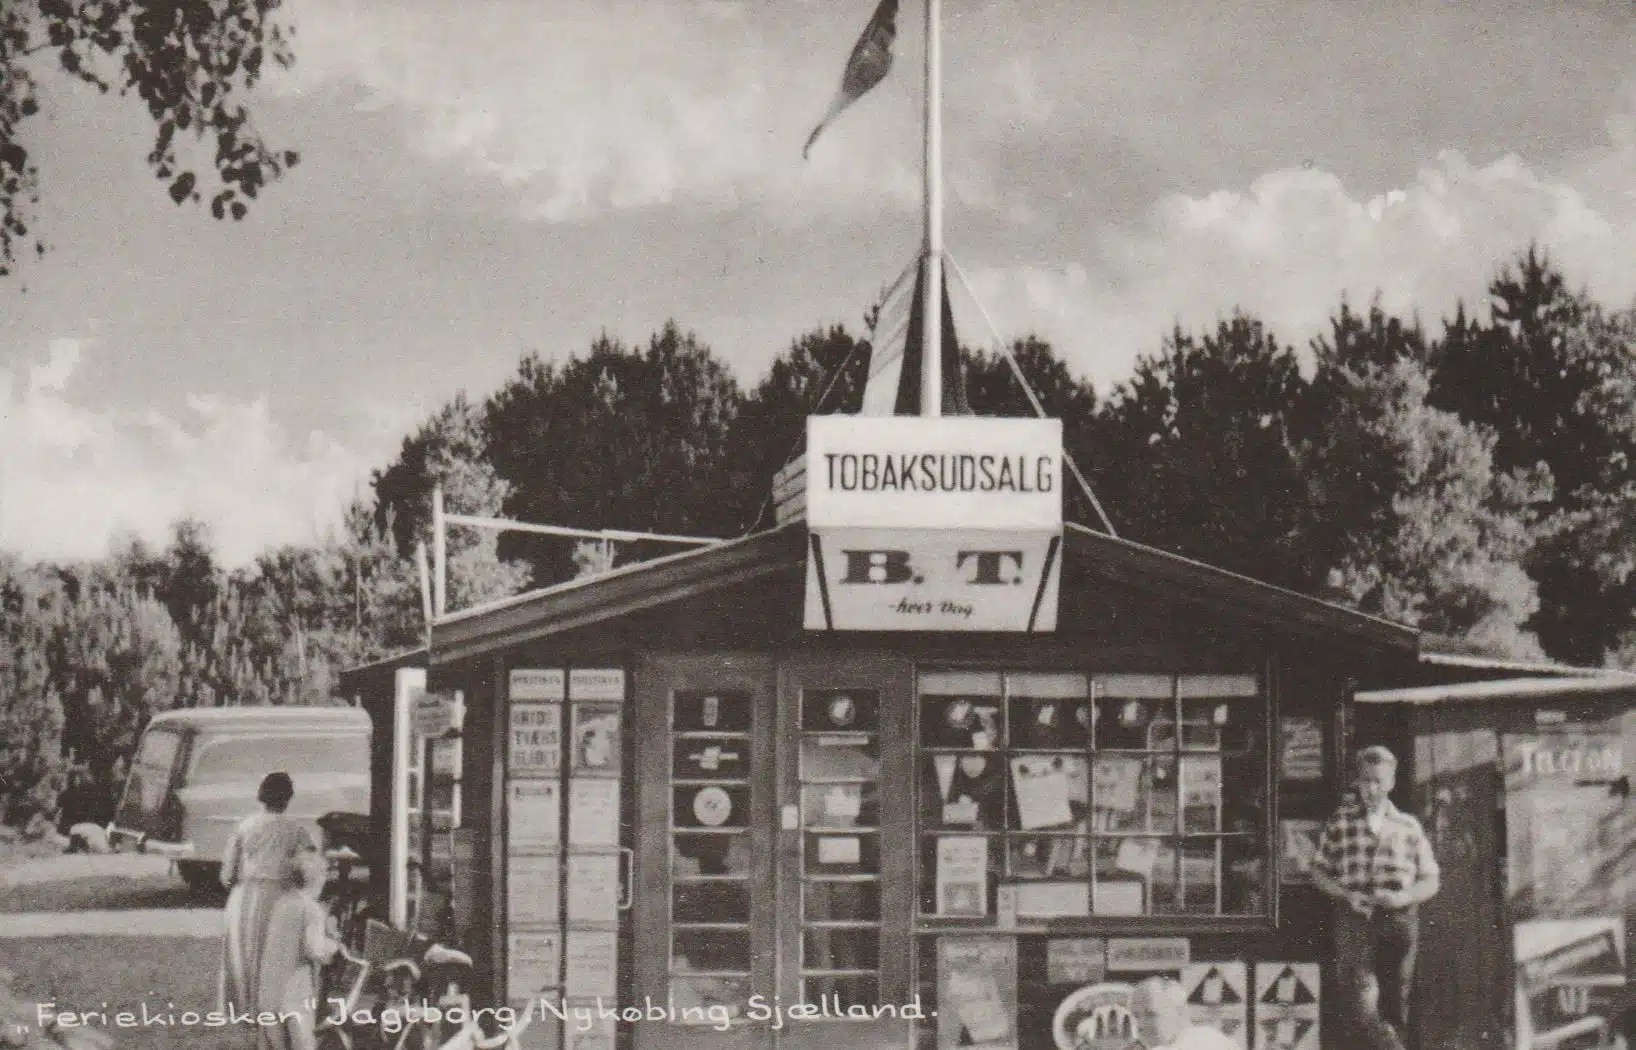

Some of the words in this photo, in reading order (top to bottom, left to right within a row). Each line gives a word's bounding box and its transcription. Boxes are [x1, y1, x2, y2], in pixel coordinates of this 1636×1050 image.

[825, 453, 1053, 493] TOBAKSUDSALG
[839, 549, 924, 585] B.
[955, 551, 1024, 586] T.
